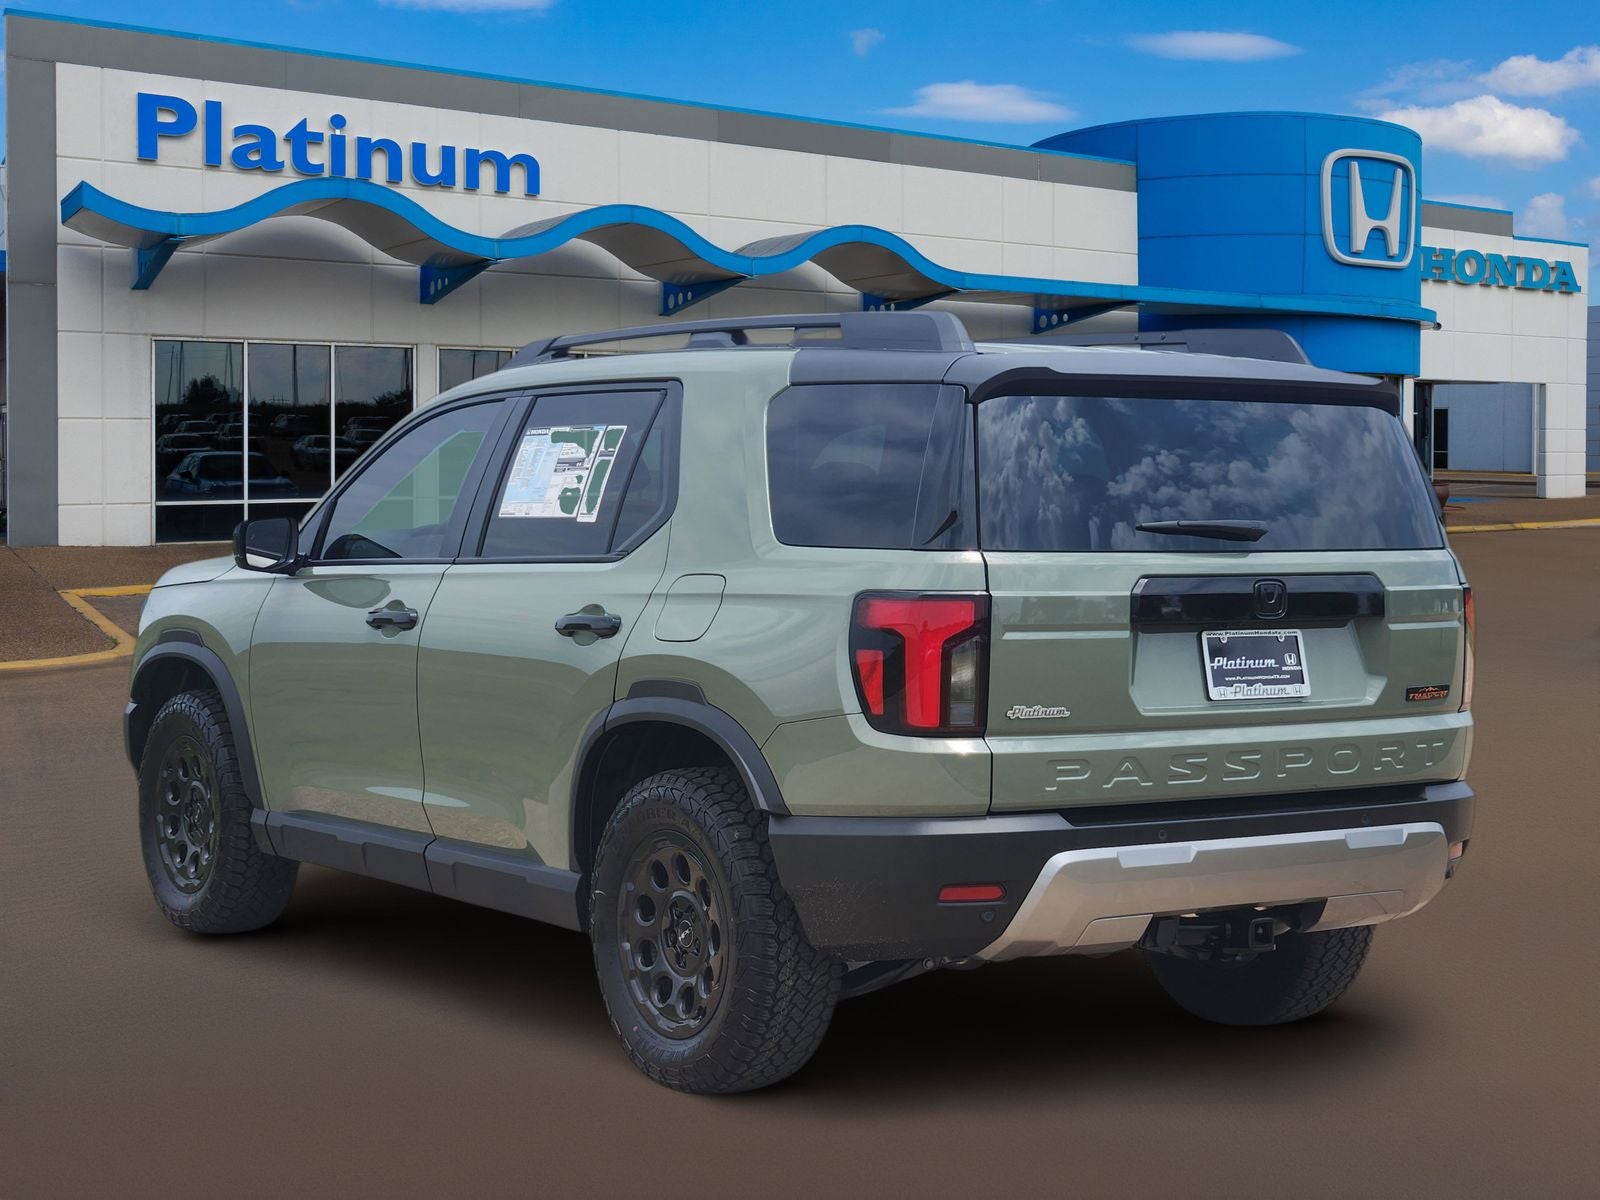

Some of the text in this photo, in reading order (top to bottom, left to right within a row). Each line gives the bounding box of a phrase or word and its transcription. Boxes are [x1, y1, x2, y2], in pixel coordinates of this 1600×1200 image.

[137, 92, 541, 197] Platinum
[1421, 246, 1581, 293] HONDA
[1210, 656, 1279, 670] Platinum
[1230, 682, 1291, 697] Platinum
[1006, 705, 1070, 719] Platinum
[1044, 740, 1448, 791] PASSPORT
